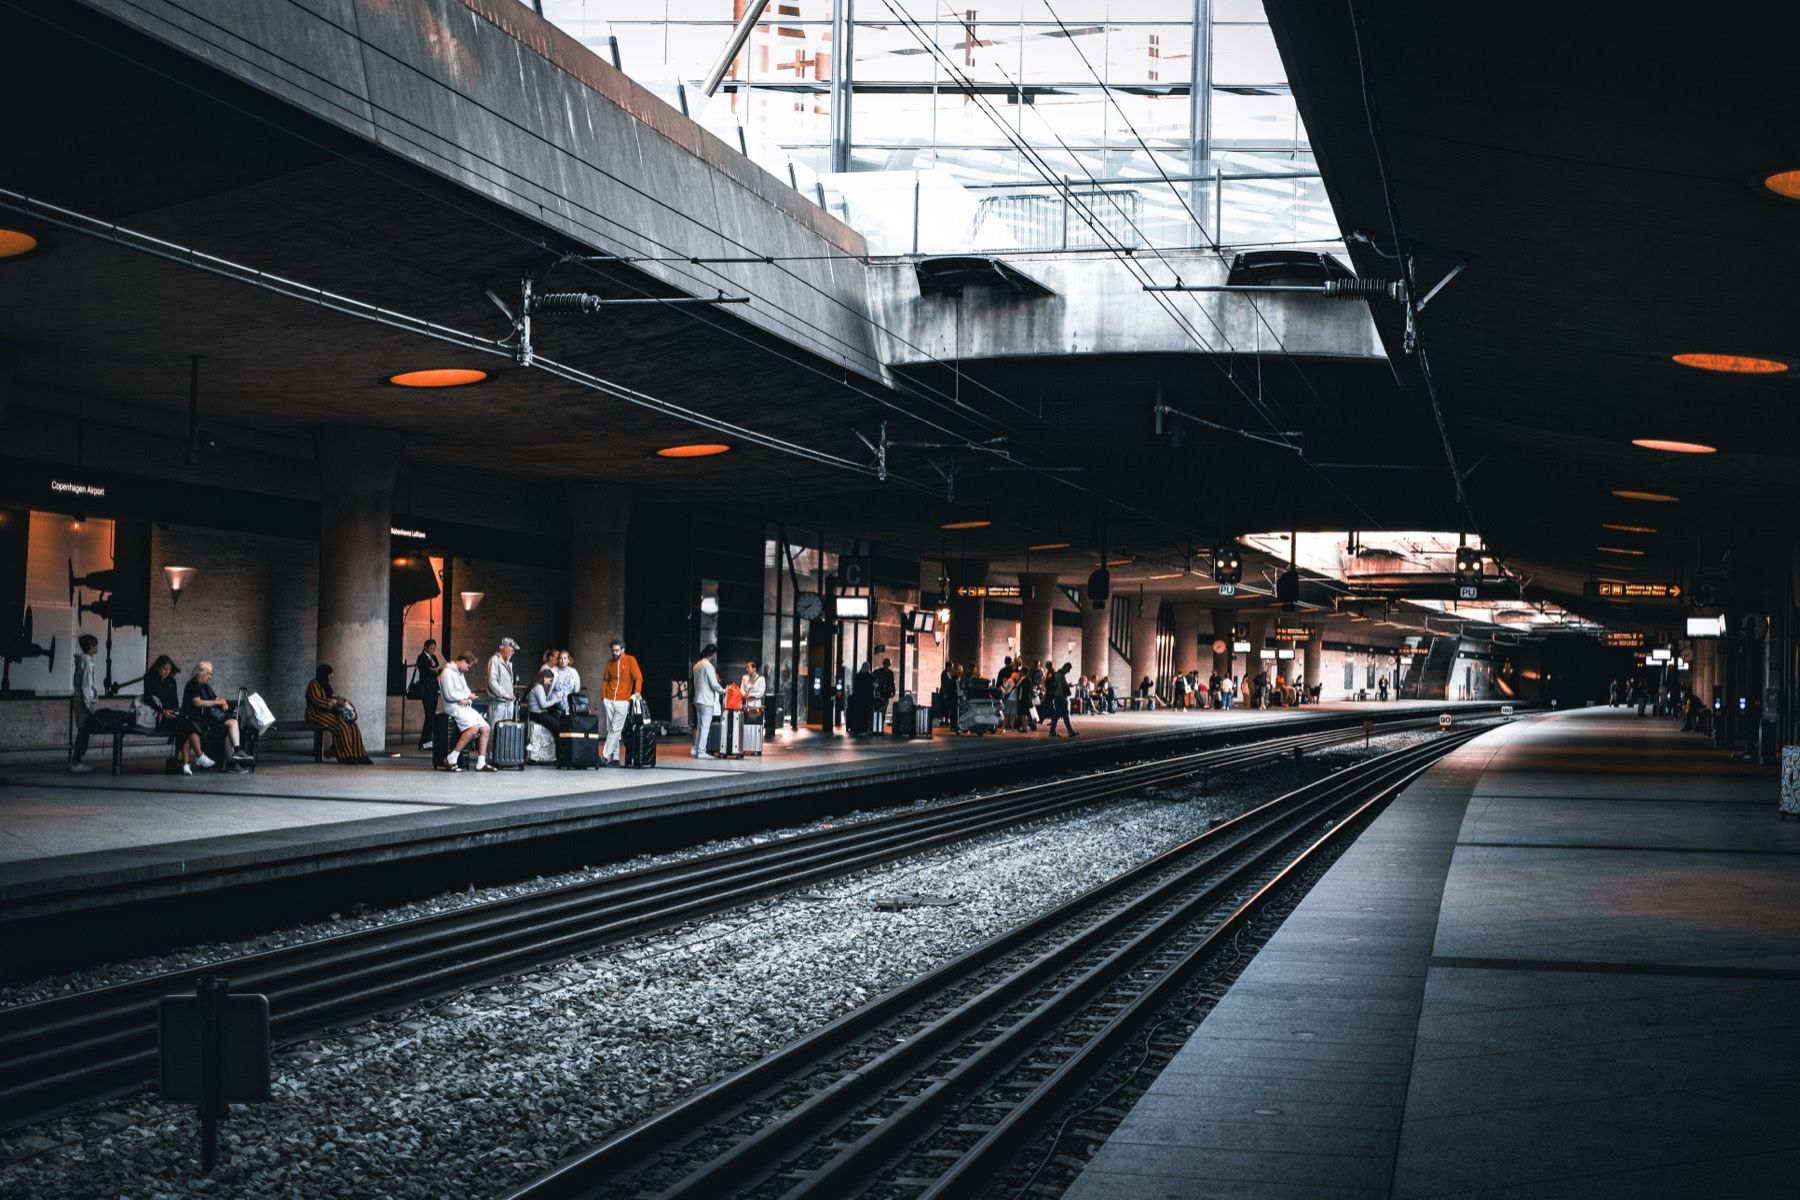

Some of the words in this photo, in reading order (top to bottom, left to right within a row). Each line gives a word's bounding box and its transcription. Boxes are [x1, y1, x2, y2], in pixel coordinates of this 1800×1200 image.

[51, 480, 86, 494] Copenhagen
[86, 485, 105, 496] Airport
[845, 564, 861, 586] C
[1220, 585, 1234, 594] PU
[1462, 588, 1476, 597] PU
[1440, 716, 1451, 724] 90
